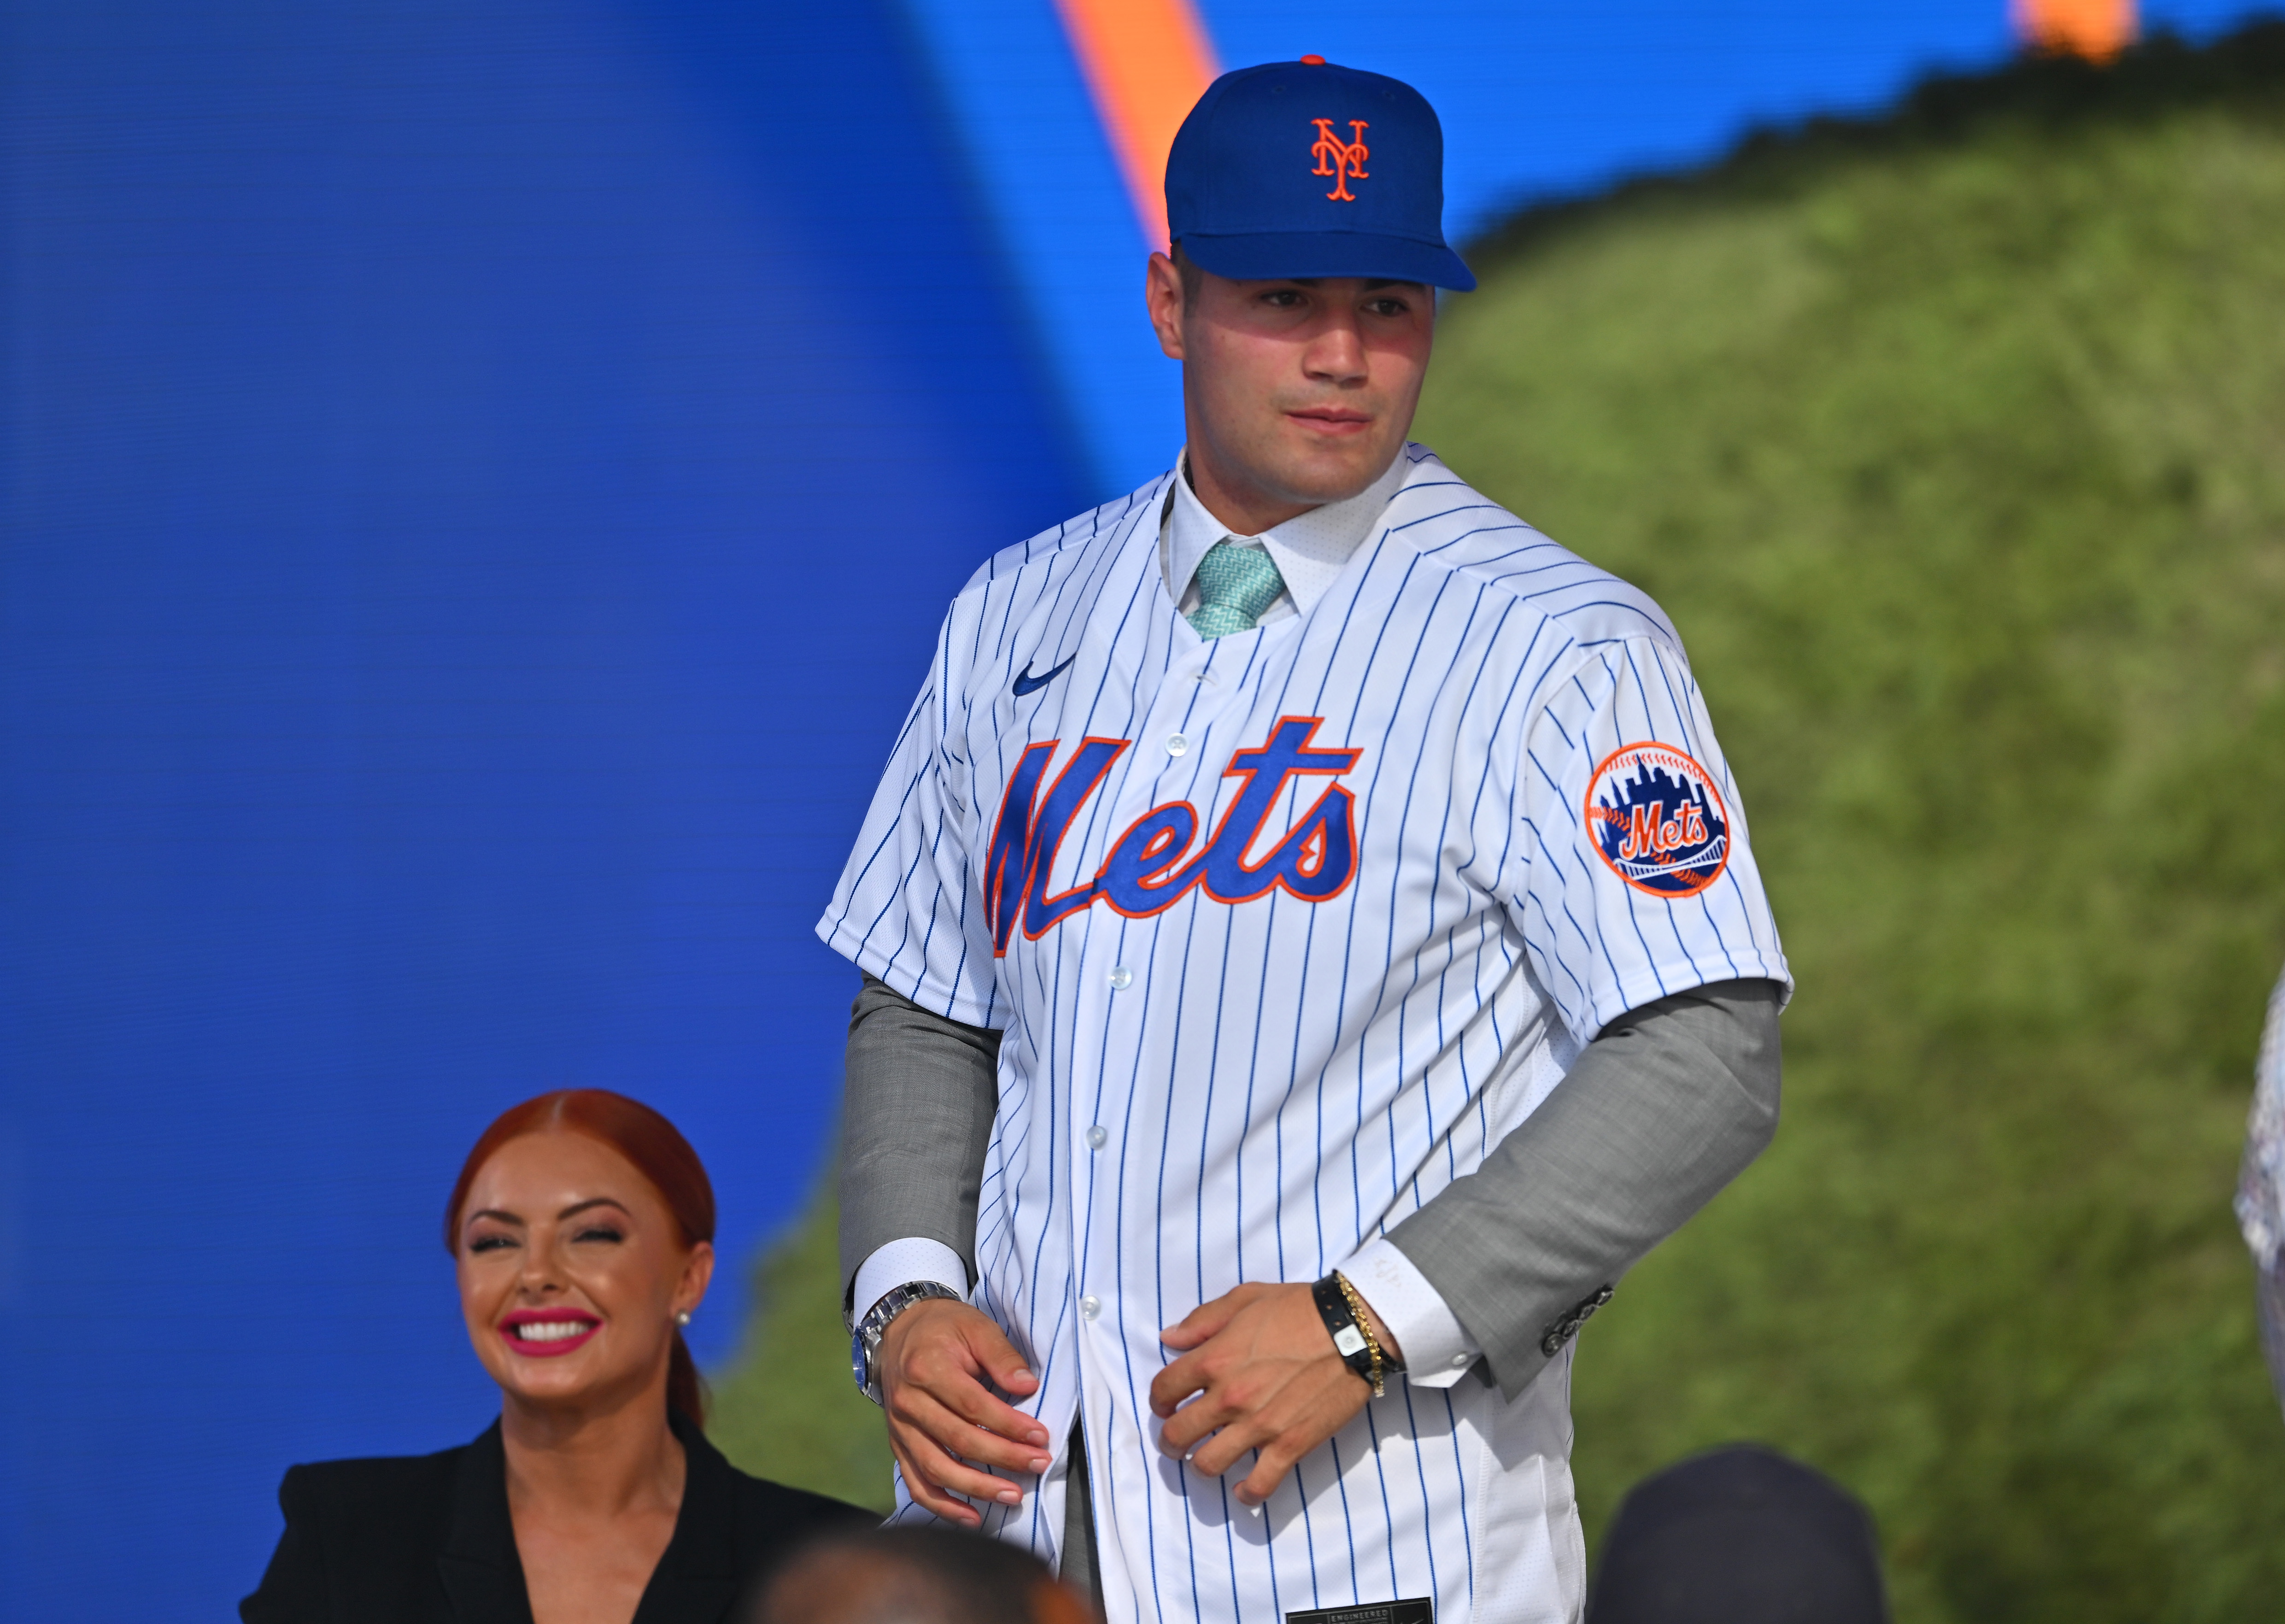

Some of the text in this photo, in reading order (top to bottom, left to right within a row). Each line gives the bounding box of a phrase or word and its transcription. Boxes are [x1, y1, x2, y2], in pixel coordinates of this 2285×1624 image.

[1311, 118, 1370, 202] NY
[983, 715, 1364, 958] Mets
[1618, 799, 1708, 861] Mets
[1330, 1609, 1389, 1622] ENGINEERED
